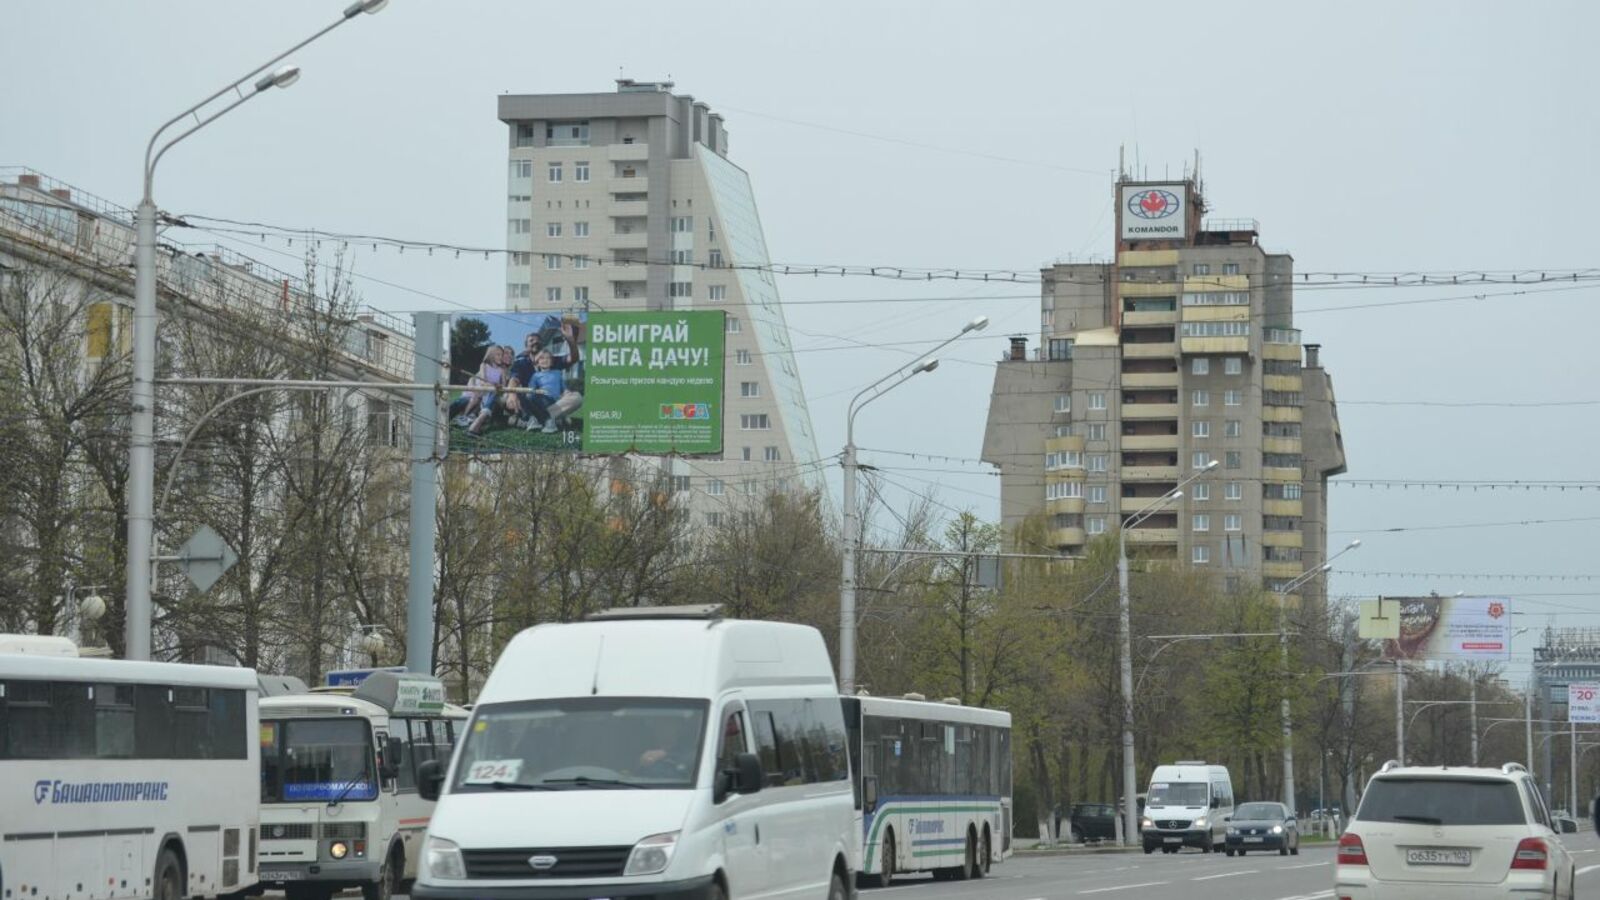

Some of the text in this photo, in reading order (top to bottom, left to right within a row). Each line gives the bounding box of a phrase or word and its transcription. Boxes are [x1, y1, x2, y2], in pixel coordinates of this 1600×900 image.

[1127, 225, 1179, 234] KOMANDOR
[591, 319, 689, 343] ВЫИГРАЙ
[591, 347, 709, 370] МЕГА ДАЧУ!
[561, 430, 581, 444] 18+
